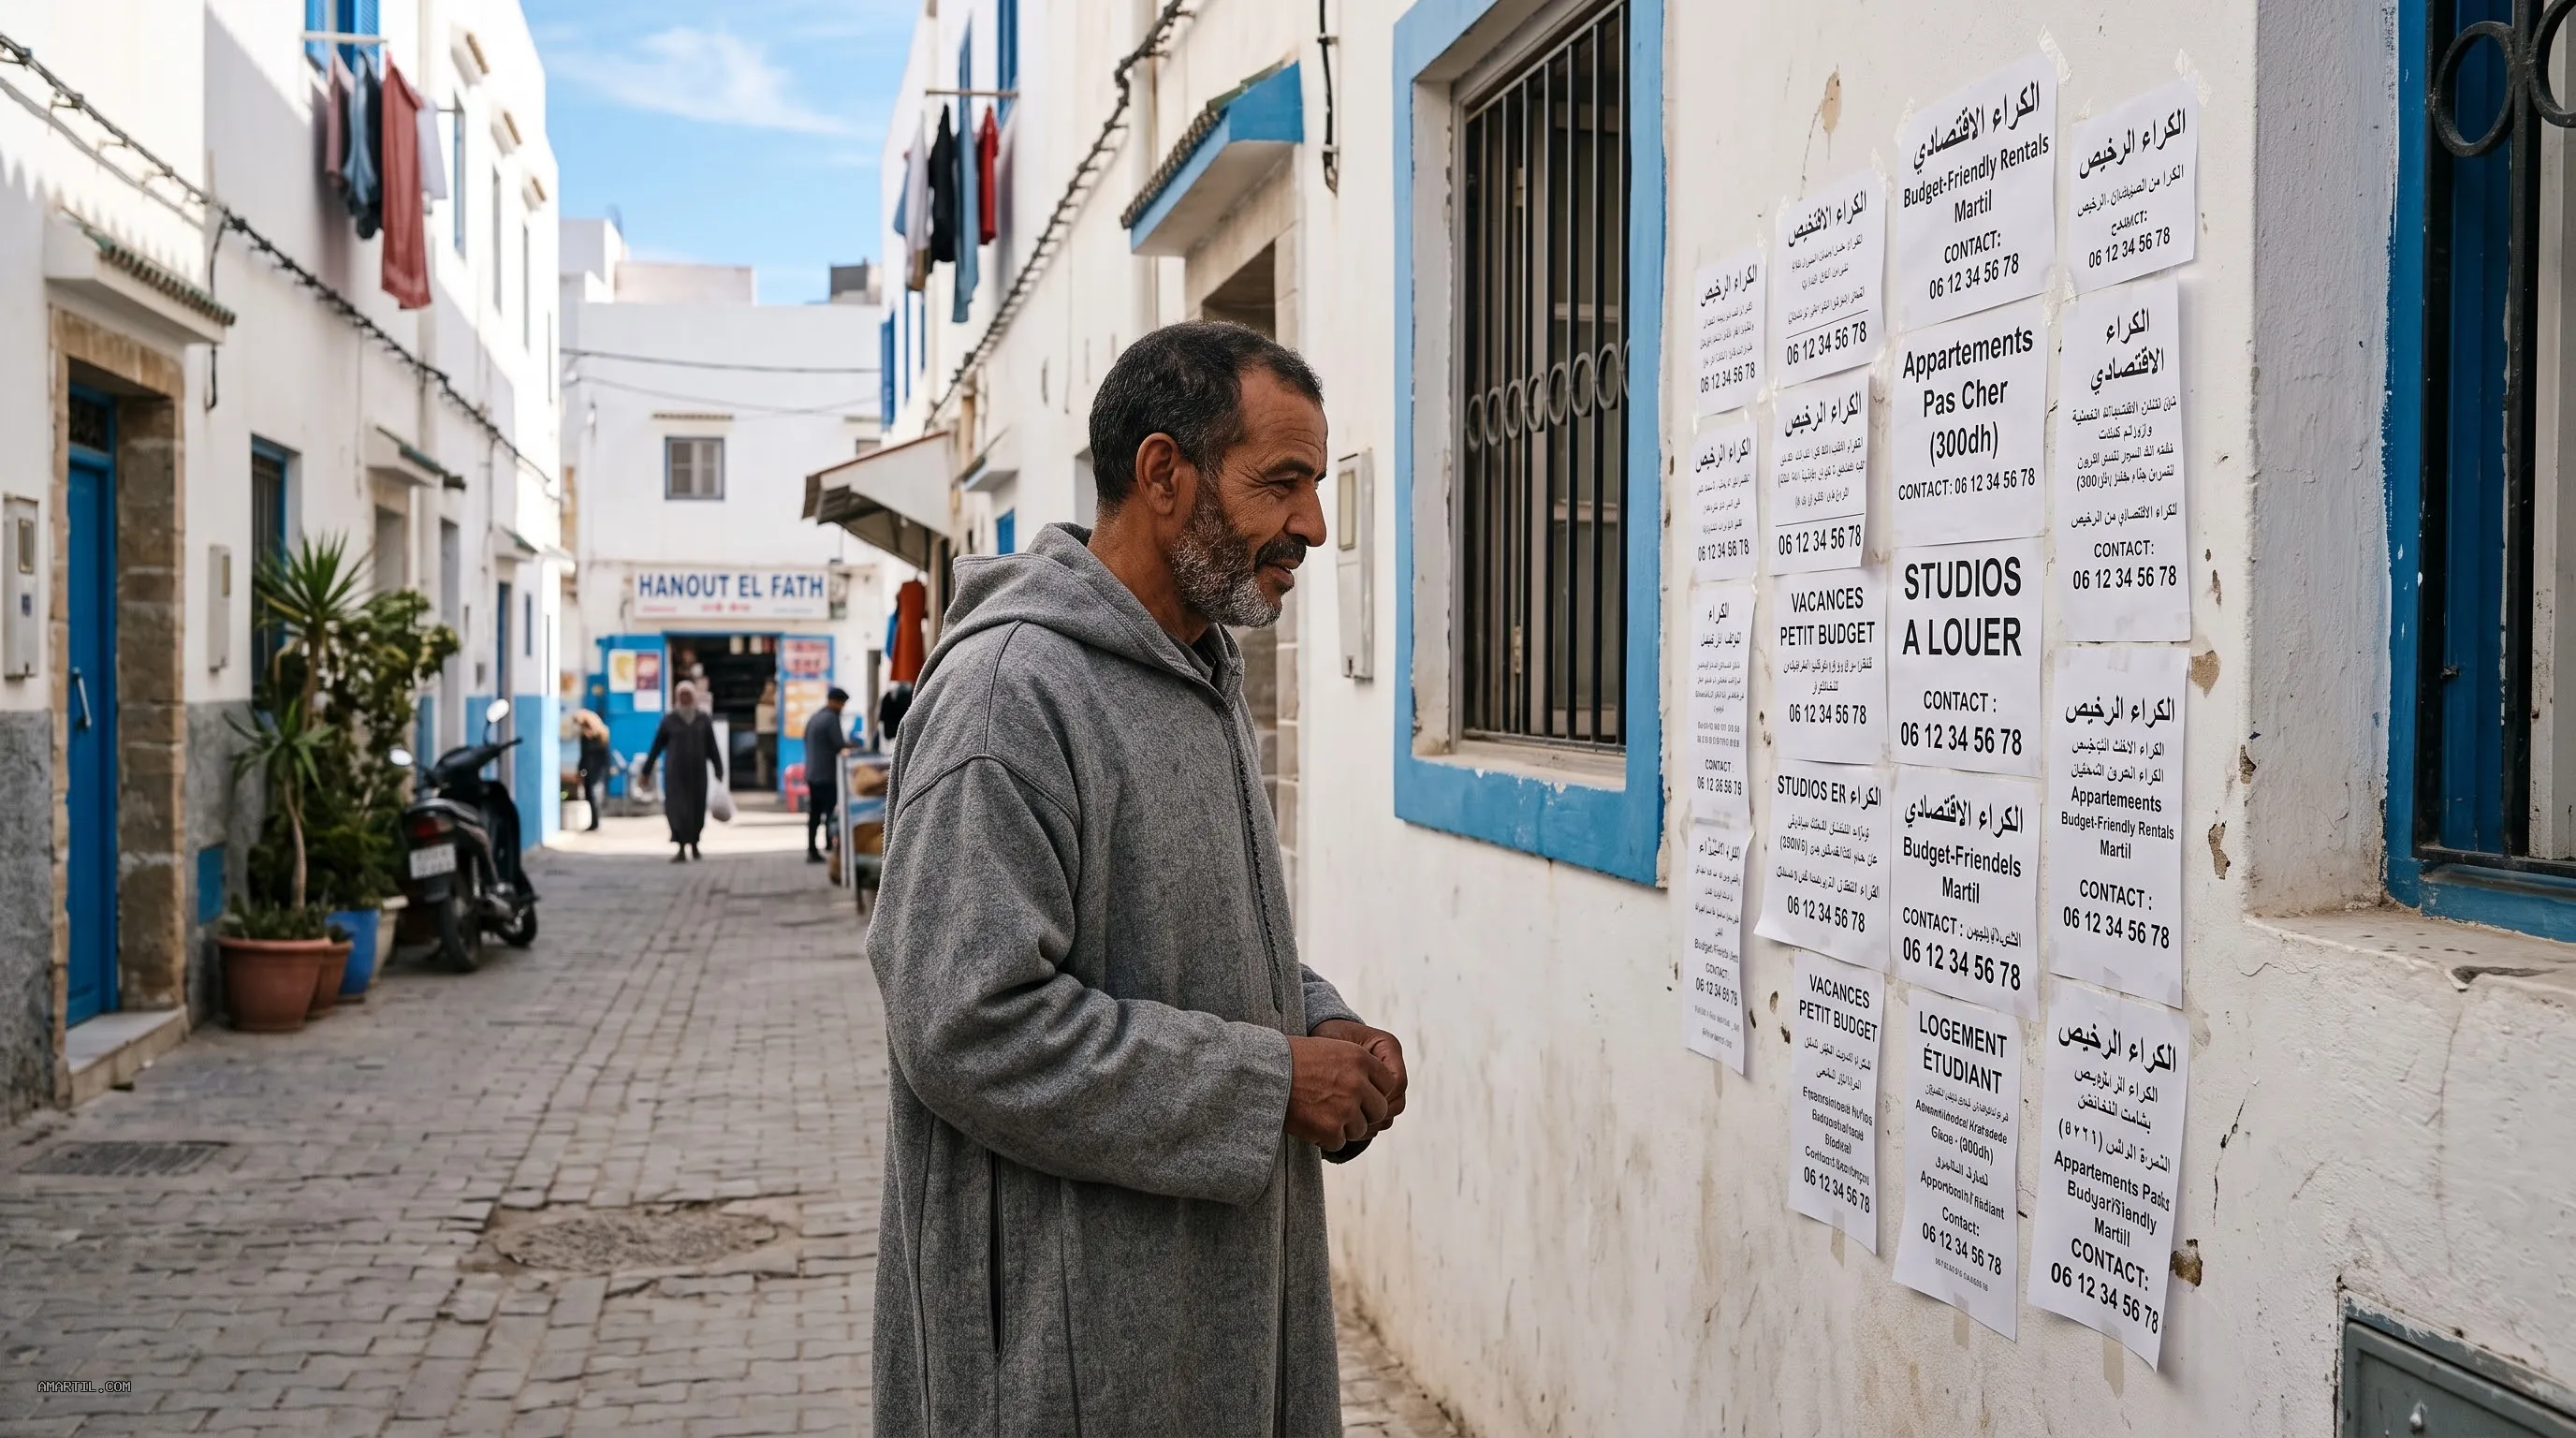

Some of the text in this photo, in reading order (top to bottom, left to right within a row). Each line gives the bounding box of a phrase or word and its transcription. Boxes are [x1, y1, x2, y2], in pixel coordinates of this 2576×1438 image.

[1914, 81, 2039, 177] الكراء الاقتصادي
[2080, 108, 2185, 179] الكراء الرخيص
[1904, 133, 2048, 211] Budget-Friendly Rentals
[1837, 191, 1866, 226] الكراء
[1955, 189, 1991, 223] Martil
[1945, 230, 2000, 266] CONTACT:
[2089, 227, 2170, 268] 06 12 34 56 78
[1701, 264, 1757, 307] الكراء الرخيص
[1930, 253, 2018, 300] 06 12 34 56 78
[1787, 321, 1866, 365] 06 12 34 56 78
[2107, 308, 2149, 344] الكراء
[1903, 327, 2033, 385] Appartements
[2091, 346, 2163, 395] الاقتصادي
[1701, 361, 1755, 393] 06 12 34 56 78
[1785, 391, 1861, 437] الكراء الرخيص
[1924, 379, 2008, 418] Pas Cher
[1729, 437, 1750, 463] الكراء
[1930, 421, 1998, 467] (300dh)
[1899, 468, 2035, 500] CONTACT: 06 12 34 56 78
[1708, 544, 1716, 560] 12
[1718, 542, 1725, 558] 34
[1778, 524, 1861, 555] 06 12 34 56 78
[2094, 540, 2154, 558] CONTACT:
[639, 575, 824, 597] HANOUT EL FATH
[1905, 557, 2021, 600] STUDIOS
[2073, 565, 2176, 590] 06 12 34 56 78
[1792, 587, 1863, 612] VACANCES
[1781, 622, 1875, 646] PETIT BUDGET
[1902, 618, 2022, 656] A LOUER
[1790, 704, 1866, 725] 06 12 34 56 78
[2066, 696, 2174, 728] الكراء الرخيص
[1901, 722, 2022, 756] 06 12 34 56 78
[2140, 742, 2164, 759] الكراء
[1707, 778, 1713, 791] 12
[1778, 775, 1827, 800] STUDIOS
[1832, 783, 1846, 803] ER
[2140, 769, 2163, 785] الكراء
[1905, 794, 1970, 829] الاقتصادي
[2071, 786, 2161, 813] Appartemeents
[1979, 803, 2023, 838] الكراء
[2062, 812, 2174, 840] Budget-Friendly Rentals
[1904, 836, 2021, 877] Budget-Friendels
[2100, 840, 2130, 858] Martil
[1942, 876, 1979, 903] Martil
[1788, 895, 1865, 932] 06 12 34 56 78
[2064, 906, 2169, 948] 06 12 34 56 78
[1904, 937, 2020, 990] 06 12 34 56 78
[1706, 981, 1713, 994] 12
[1808, 974, 1869, 1011] VACANCES
[1800, 1000, 1877, 1042] PETIT BUDGET
[1920, 1011, 2007, 1060] LOGEMENT
[2058, 1023, 2175, 1073] الكراء الرخيص
[1924, 1041, 2003, 1096] ÉTUDIANT
[2129, 1082, 2158, 1103] الكراء
[1805, 1167, 1869, 1213] 06 12 34 56 78
[2054, 1149, 2138, 1199] Appartements
[1940, 1207, 1979, 1239] Contact:
[2095, 1215, 2131, 1247] Martill
[1923, 1223, 1936, 1242] 06
[1939, 1230, 1952, 1251] 12
[1955, 1238, 1968, 1258] 34
[1972, 1246, 1983, 1267] 56
[1988, 1254, 2001, 1275] 78
[2071, 1236, 2148, 1294] CONTACT:
[2051, 1263, 2159, 1334] 06 12 34 56 78
